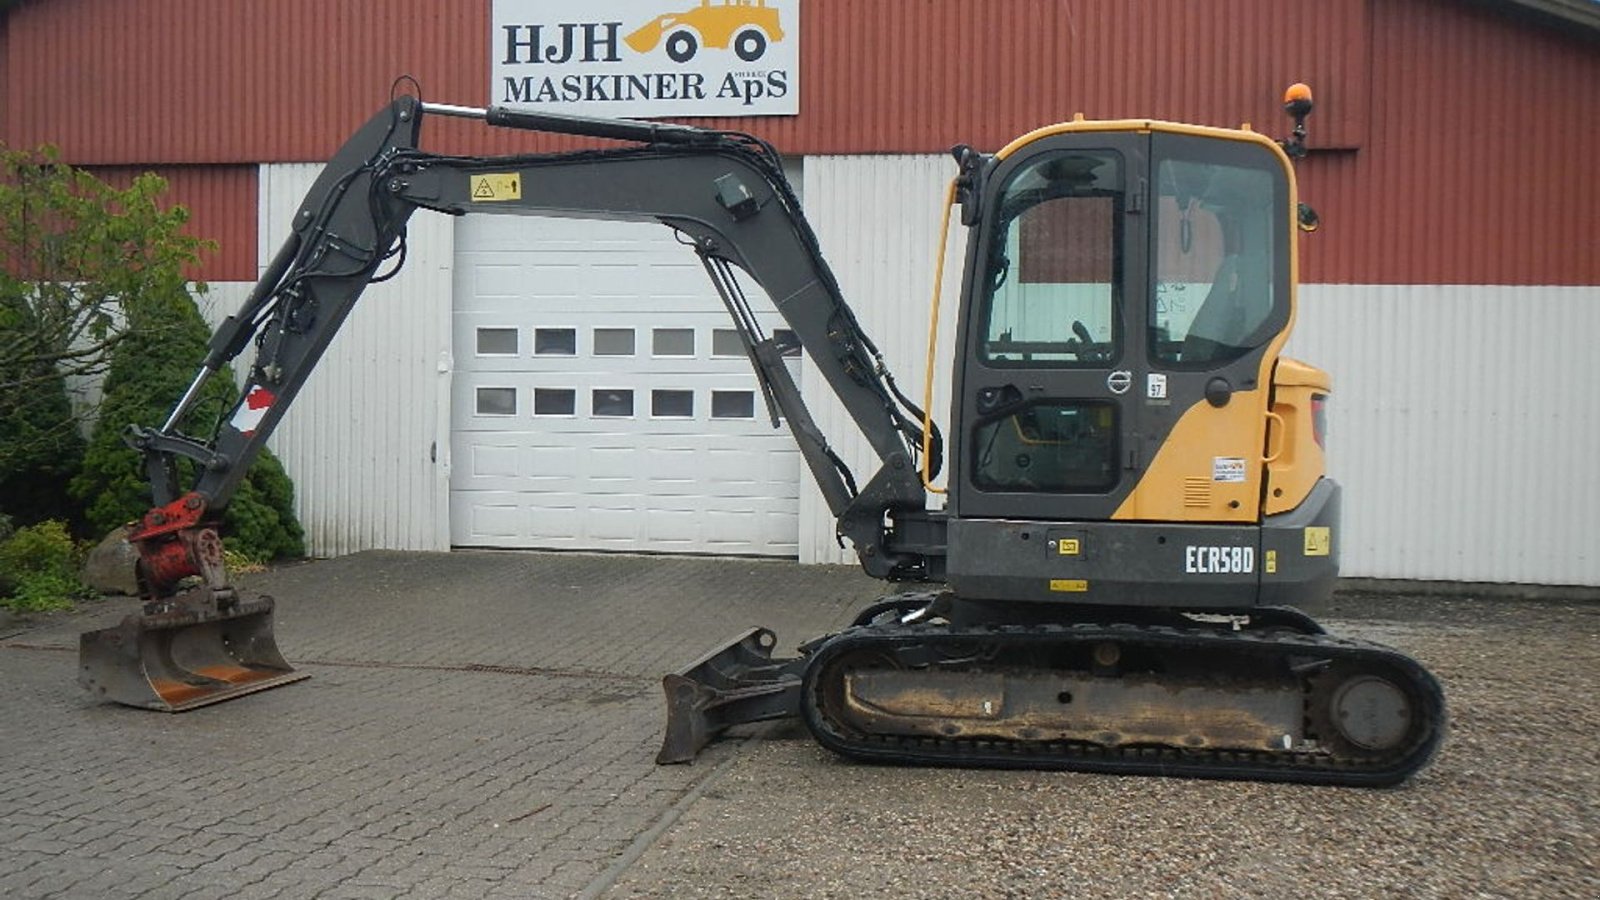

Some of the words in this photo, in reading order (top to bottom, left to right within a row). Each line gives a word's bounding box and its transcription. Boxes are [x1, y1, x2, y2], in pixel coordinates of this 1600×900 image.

[502, 22, 623, 65] HJH
[504, 73, 707, 103] MASKINER
[716, 70, 787, 105] ApS
[1185, 545, 1254, 574] ECR58D
